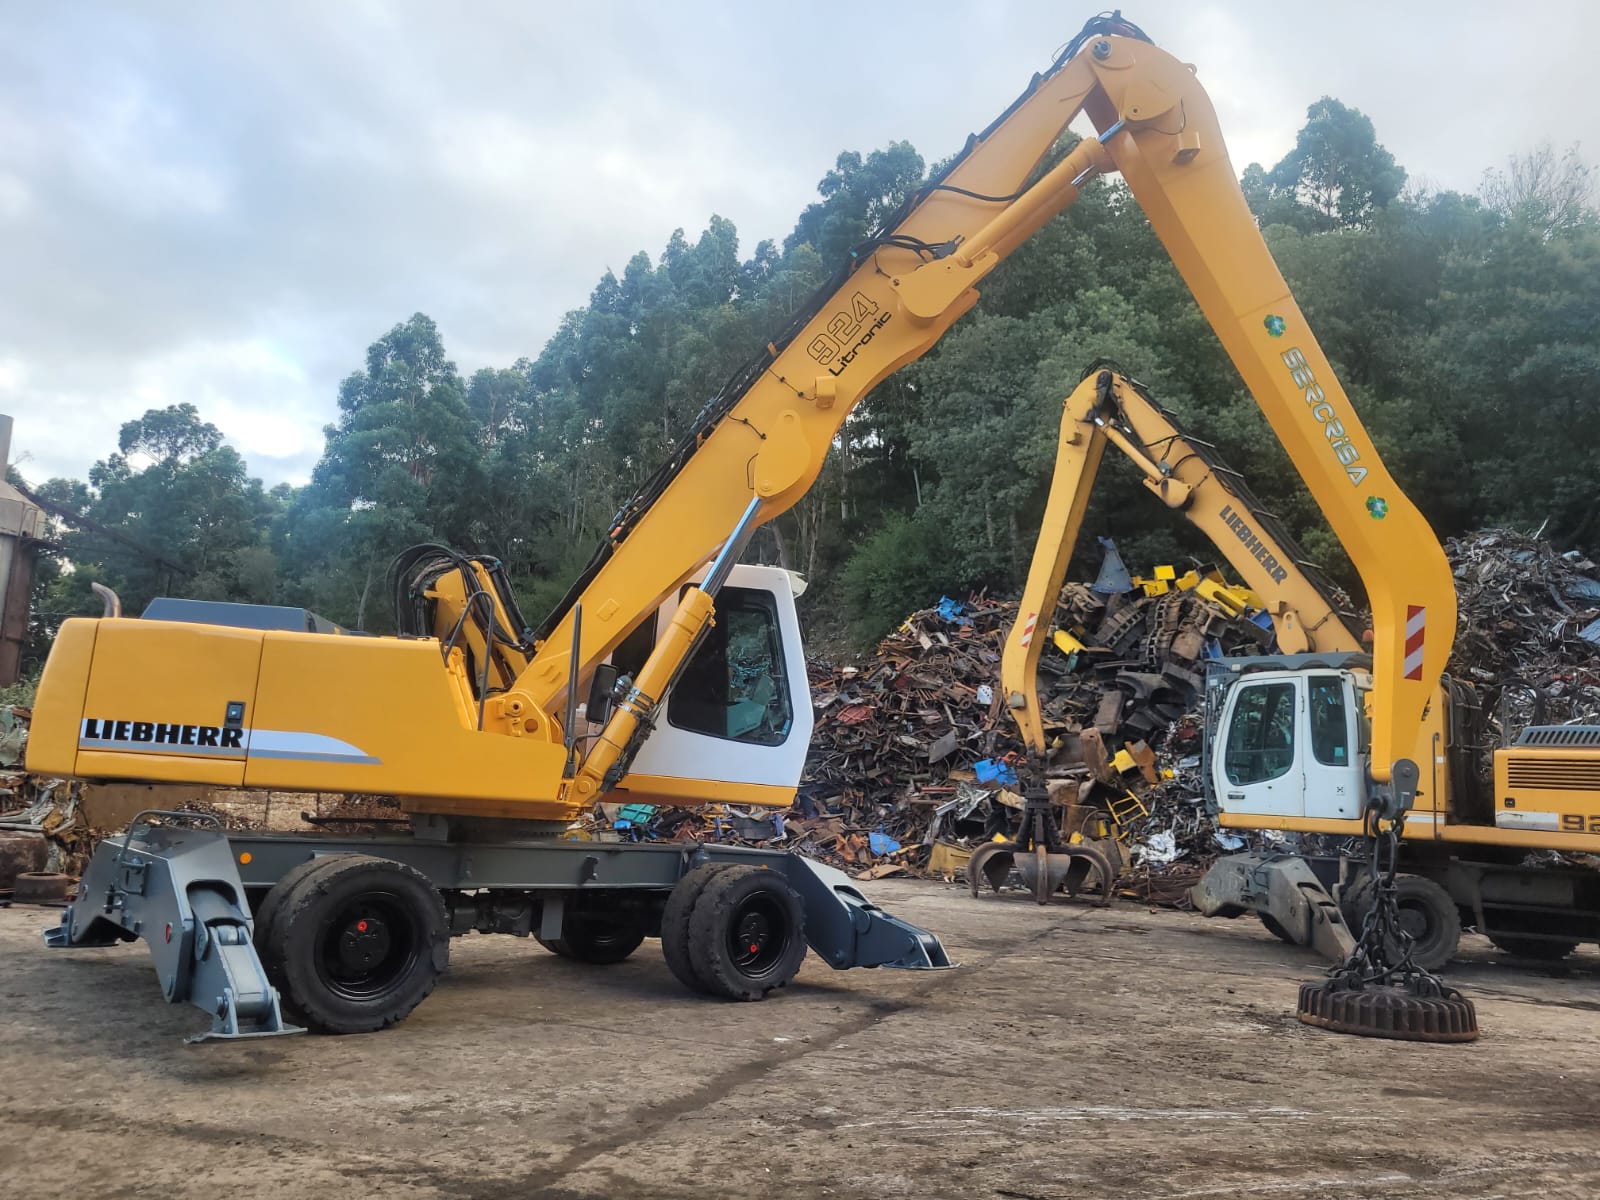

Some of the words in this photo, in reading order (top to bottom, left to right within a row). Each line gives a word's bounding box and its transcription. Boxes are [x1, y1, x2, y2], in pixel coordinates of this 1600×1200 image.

[807, 290, 880, 366] 924
[828, 311, 892, 377] Litronic
[1219, 504, 1288, 586] LIEBHERR
[84, 718, 244, 748] LIEBHERR
